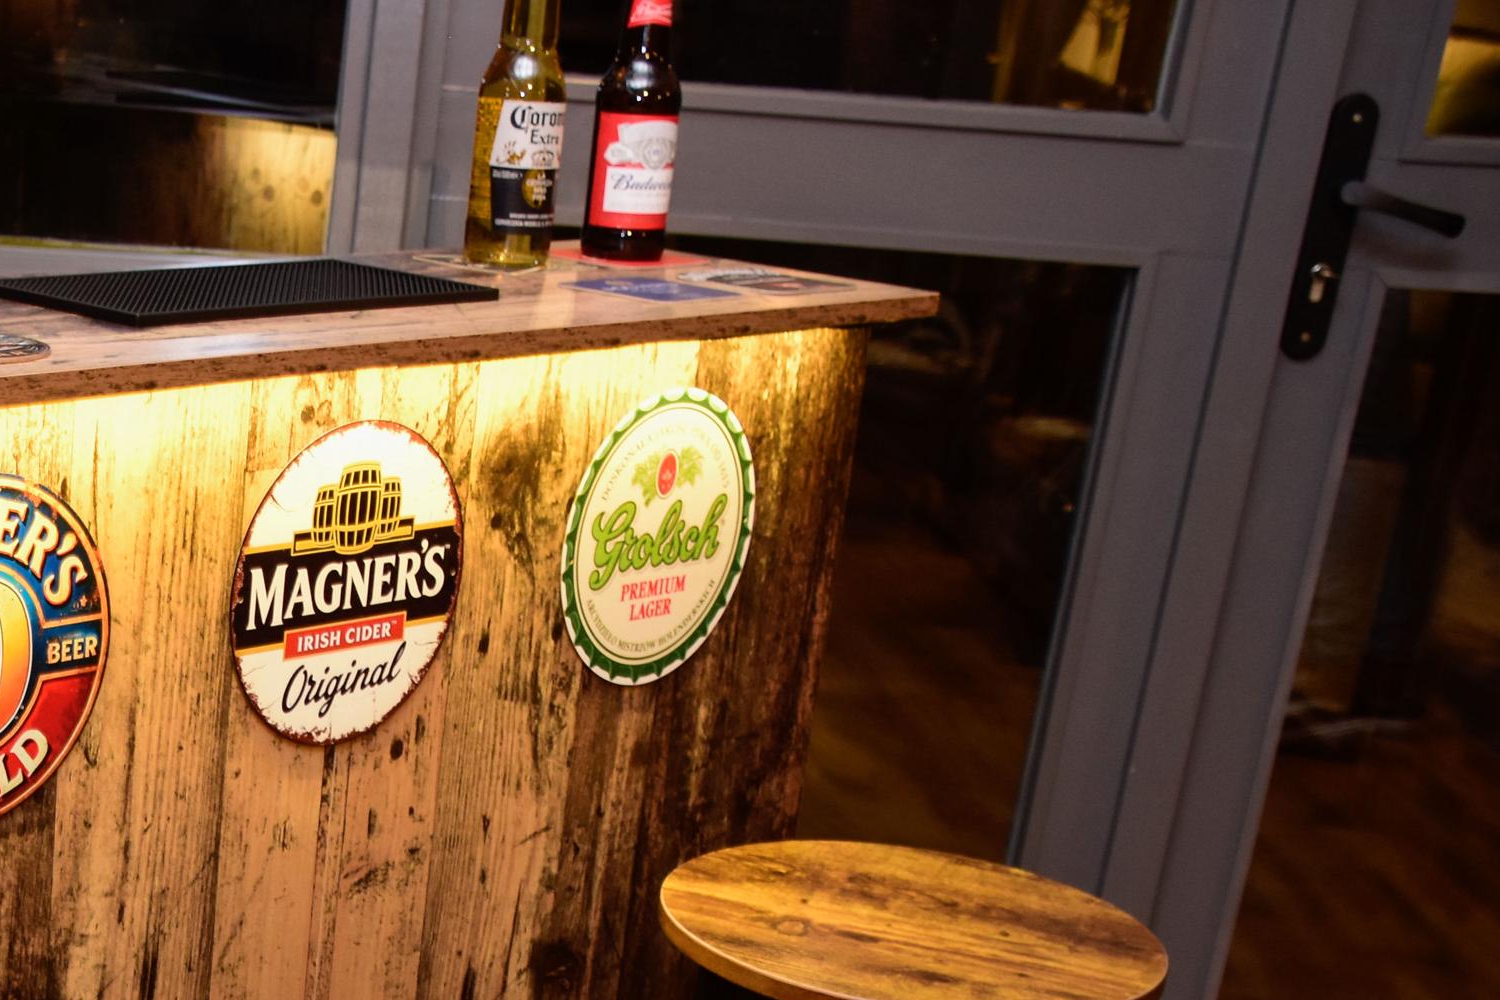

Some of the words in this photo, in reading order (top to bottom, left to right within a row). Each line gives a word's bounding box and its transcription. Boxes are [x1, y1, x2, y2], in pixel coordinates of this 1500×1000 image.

[510, 104, 566, 133] Coron
[588, 492, 729, 592] Grolsch
[245, 537, 446, 631] MAGNER'S
[620, 574, 687, 602] PREMIUM
[629, 597, 672, 622] LAGER
[46, 635, 99, 665] BEER
[296, 628, 342, 653] IRISH
[344, 619, 393, 645] CIDER
[280, 640, 408, 719] Original
